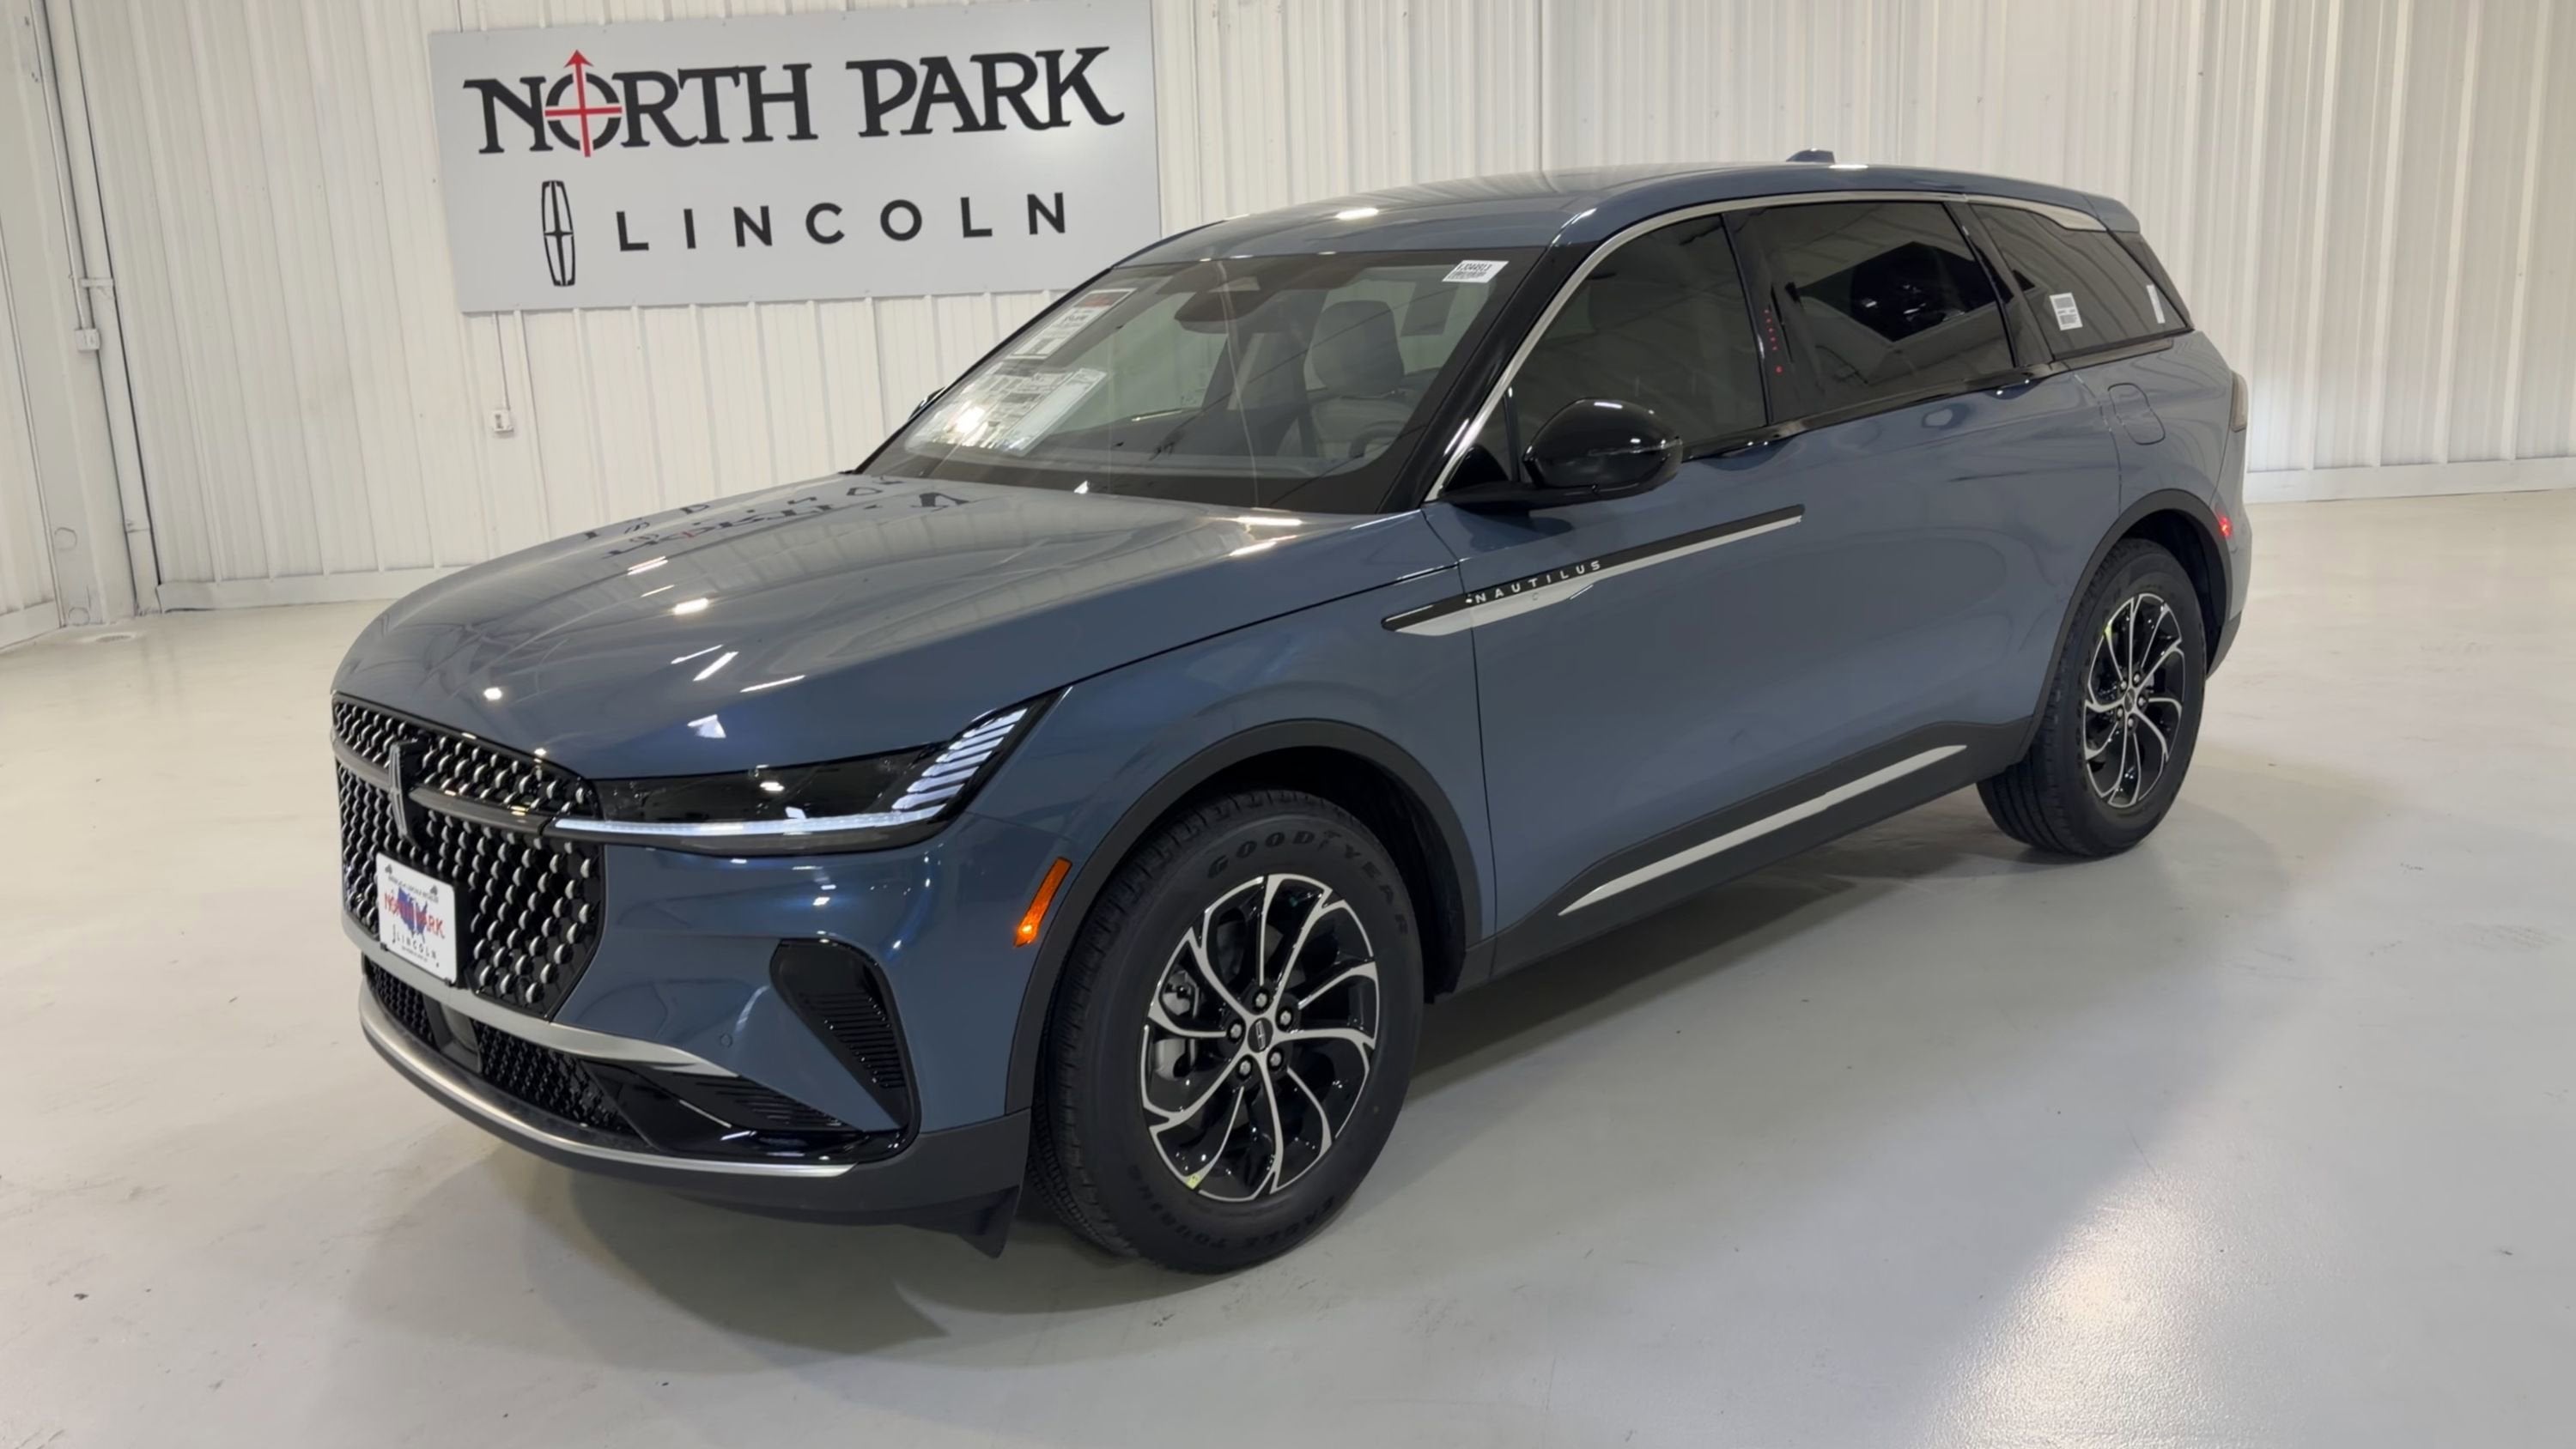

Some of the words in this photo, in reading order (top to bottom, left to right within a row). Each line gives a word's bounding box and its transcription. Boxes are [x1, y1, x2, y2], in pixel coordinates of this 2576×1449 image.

[463, 63, 819, 155] NORTH
[846, 45, 1126, 138] PARK
[616, 191, 1066, 252] LINCOLN
[1474, 560, 1601, 604] NAUTILUS
[1206, 829, 1409, 936] GOODYEAR
